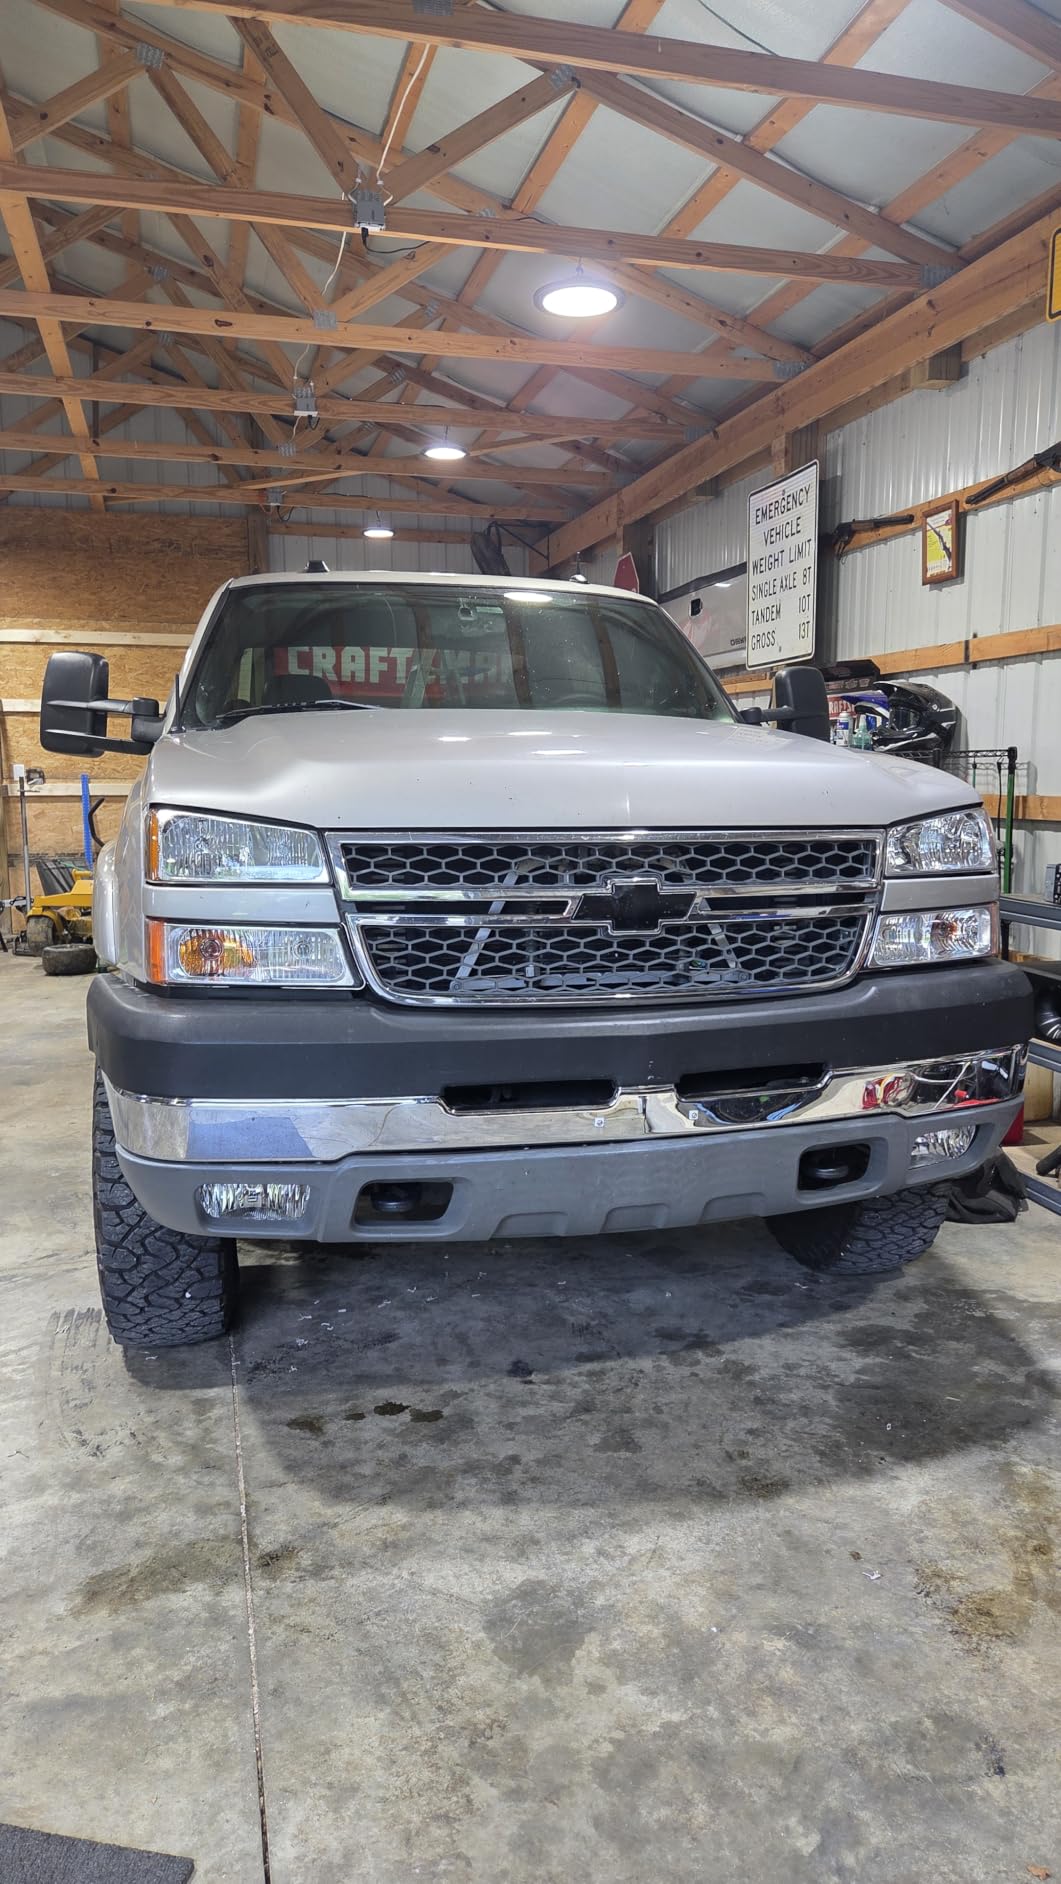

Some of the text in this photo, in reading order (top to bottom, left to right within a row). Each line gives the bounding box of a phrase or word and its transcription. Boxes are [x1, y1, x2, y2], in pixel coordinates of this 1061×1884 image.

[755, 484, 811, 525] EMERGENCY
[763, 517, 801, 547] VEHICLE
[752, 539, 812, 577] WEIGHT LIMIT
[752, 566, 812, 602] SINGLE AXLE 8T
[751, 594, 811, 626] TANDEM 10T
[751, 630, 776, 651] GROSS
[798, 621, 811, 641] 13T
